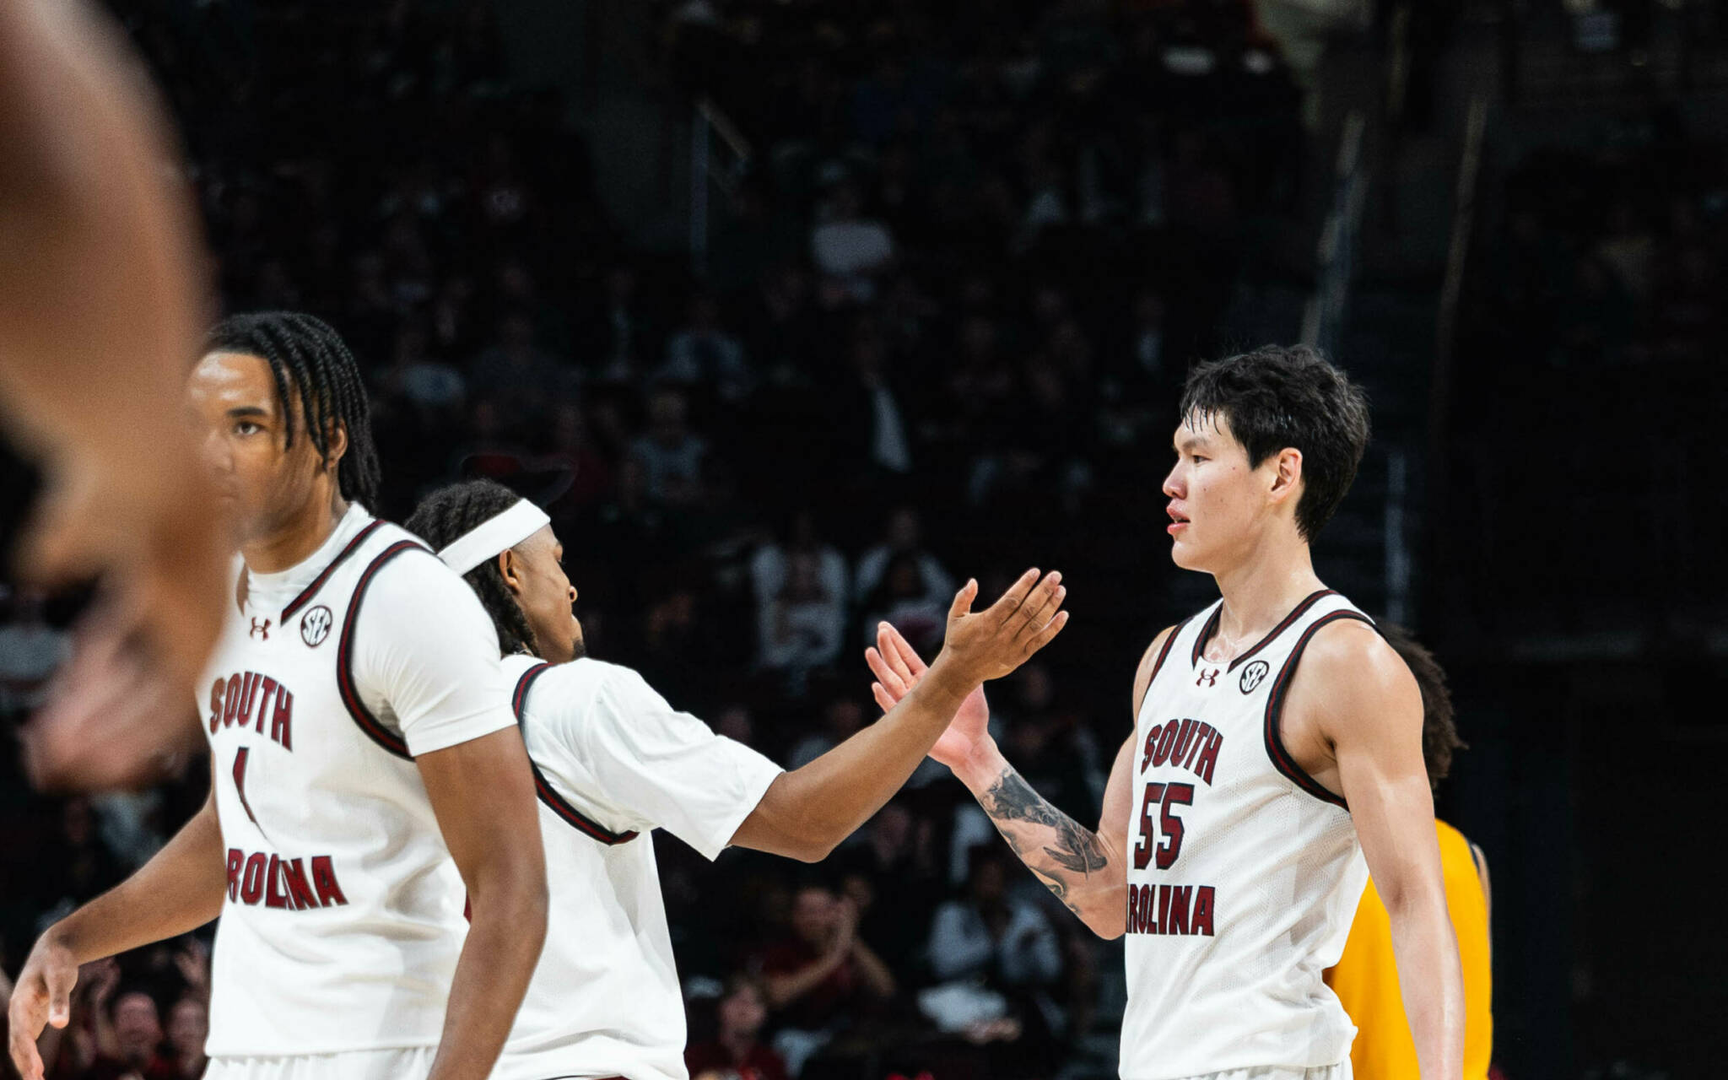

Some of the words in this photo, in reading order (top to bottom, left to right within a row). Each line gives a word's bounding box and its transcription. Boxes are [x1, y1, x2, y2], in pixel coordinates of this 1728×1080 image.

[210, 671, 294, 752] SOUTH
[1141, 718, 1223, 786] SOUTH
[1134, 782, 1195, 870] 55
[226, 848, 349, 911] ROLNA
[1126, 884, 1215, 936] ROLINA
